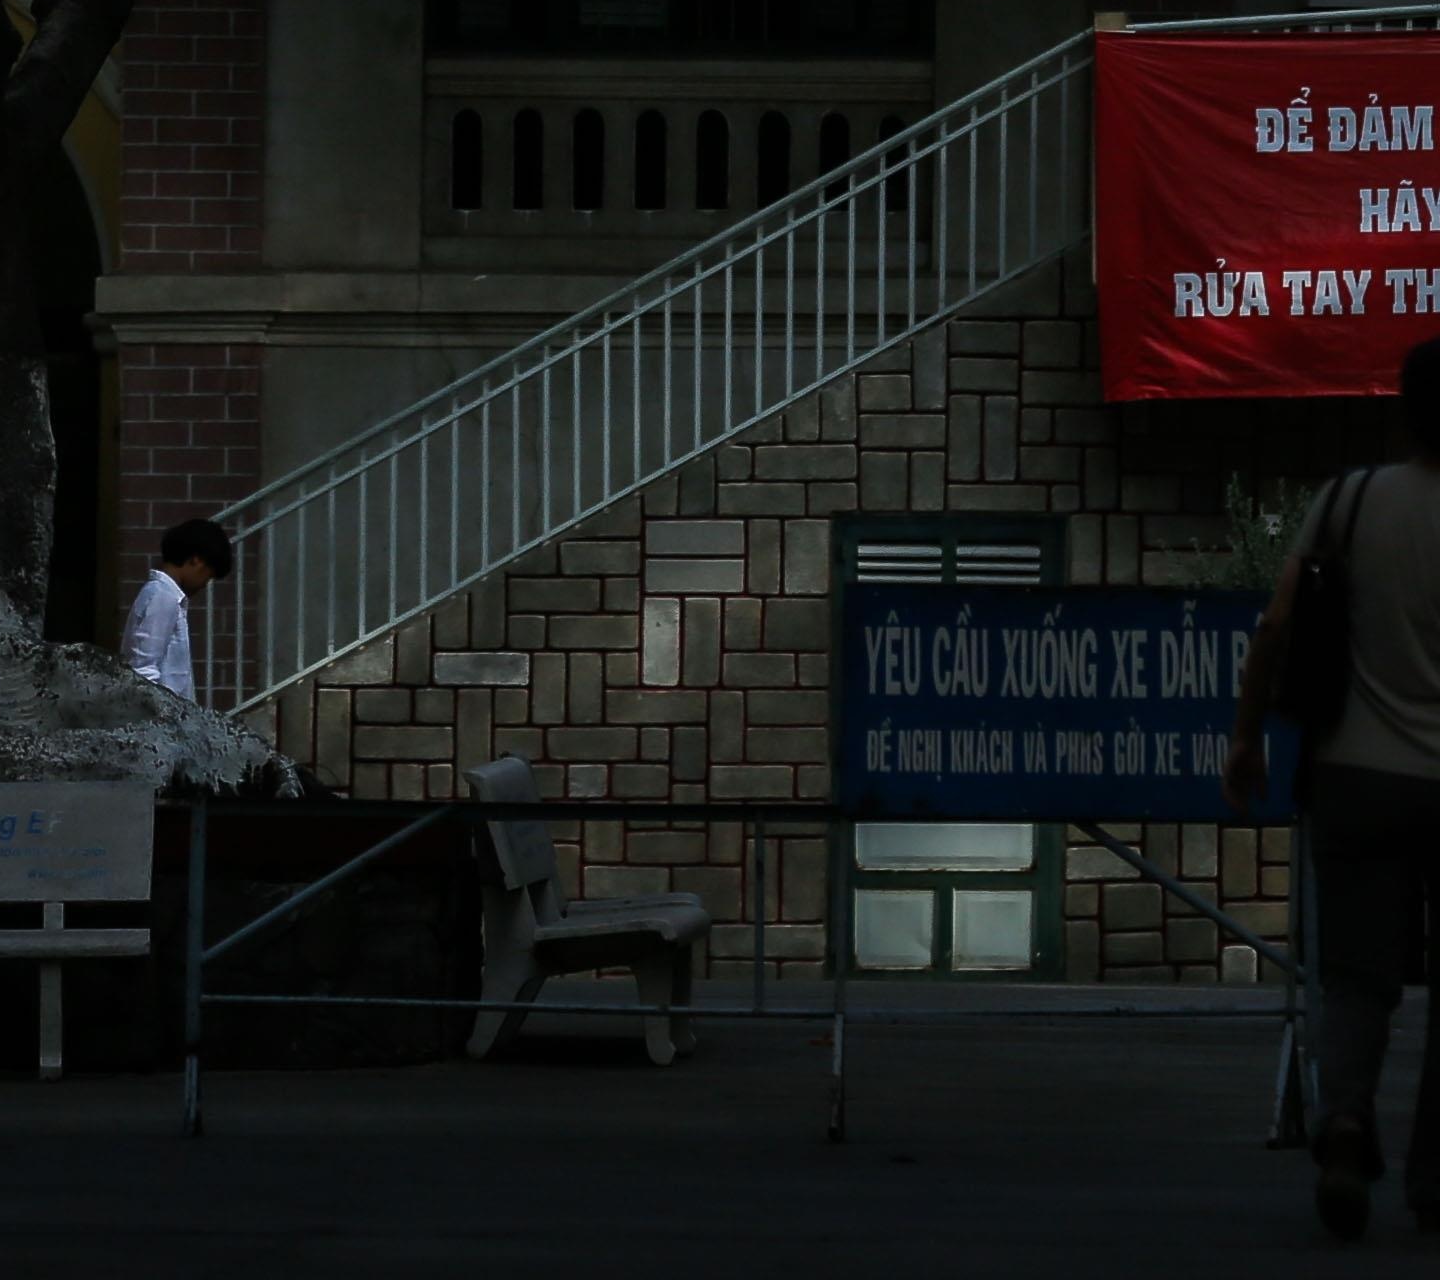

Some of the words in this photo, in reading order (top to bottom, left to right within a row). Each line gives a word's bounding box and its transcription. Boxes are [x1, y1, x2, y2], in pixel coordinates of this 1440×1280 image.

[1255, 87, 1313, 152] ĐỂ
[1328, 93, 1434, 150] ĐẢM
[1173, 258, 1271, 318] RỬA
[1283, 269, 1372, 316] TAY
[864, 609, 921, 697] YÊU
[931, 602, 990, 698] CẦU
[1000, 602, 1099, 699] XUỐNG
[1109, 628, 1150, 699] XE
[1160, 600, 1220, 699] DẪN
[897, 728, 943, 783] NGHỊ
[950, 720, 1013, 775] KHÁCH
[1023, 720, 1048, 774] VÀ
[1154, 732, 1181, 776] XE
